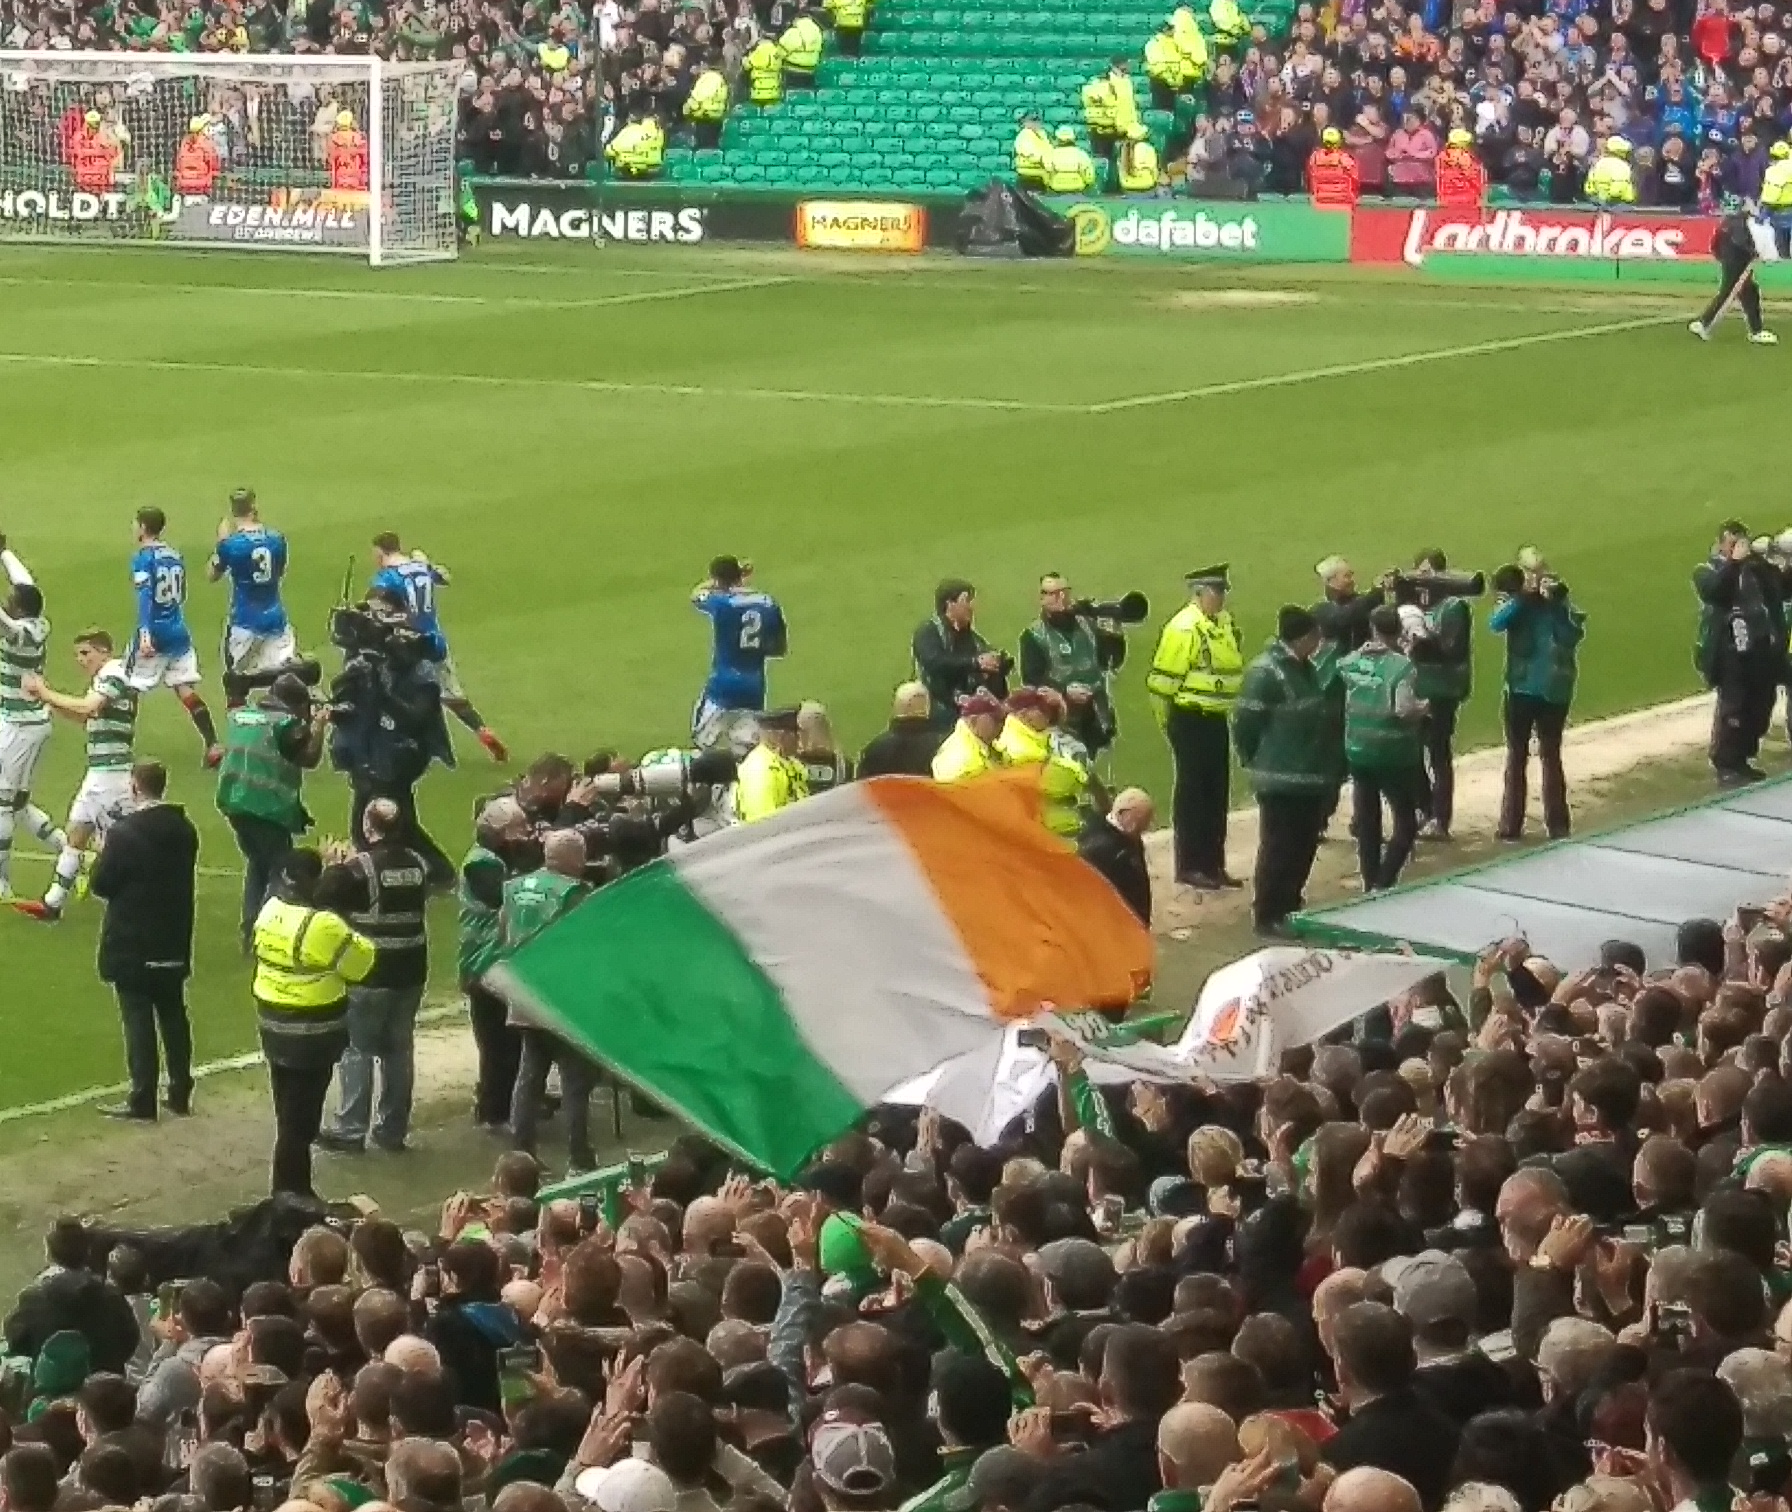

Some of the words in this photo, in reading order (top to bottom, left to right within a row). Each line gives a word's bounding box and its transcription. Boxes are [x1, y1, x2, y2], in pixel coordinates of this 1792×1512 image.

[491, 201, 705, 242] MAGNERS
[811, 214, 912, 233] MAGNERS
[1113, 206, 1259, 251] dafabet
[1403, 209, 1686, 268] Ladbrokes
[154, 565, 185, 605] 20
[250, 546, 273, 584] 3
[740, 611, 761, 649] 2
